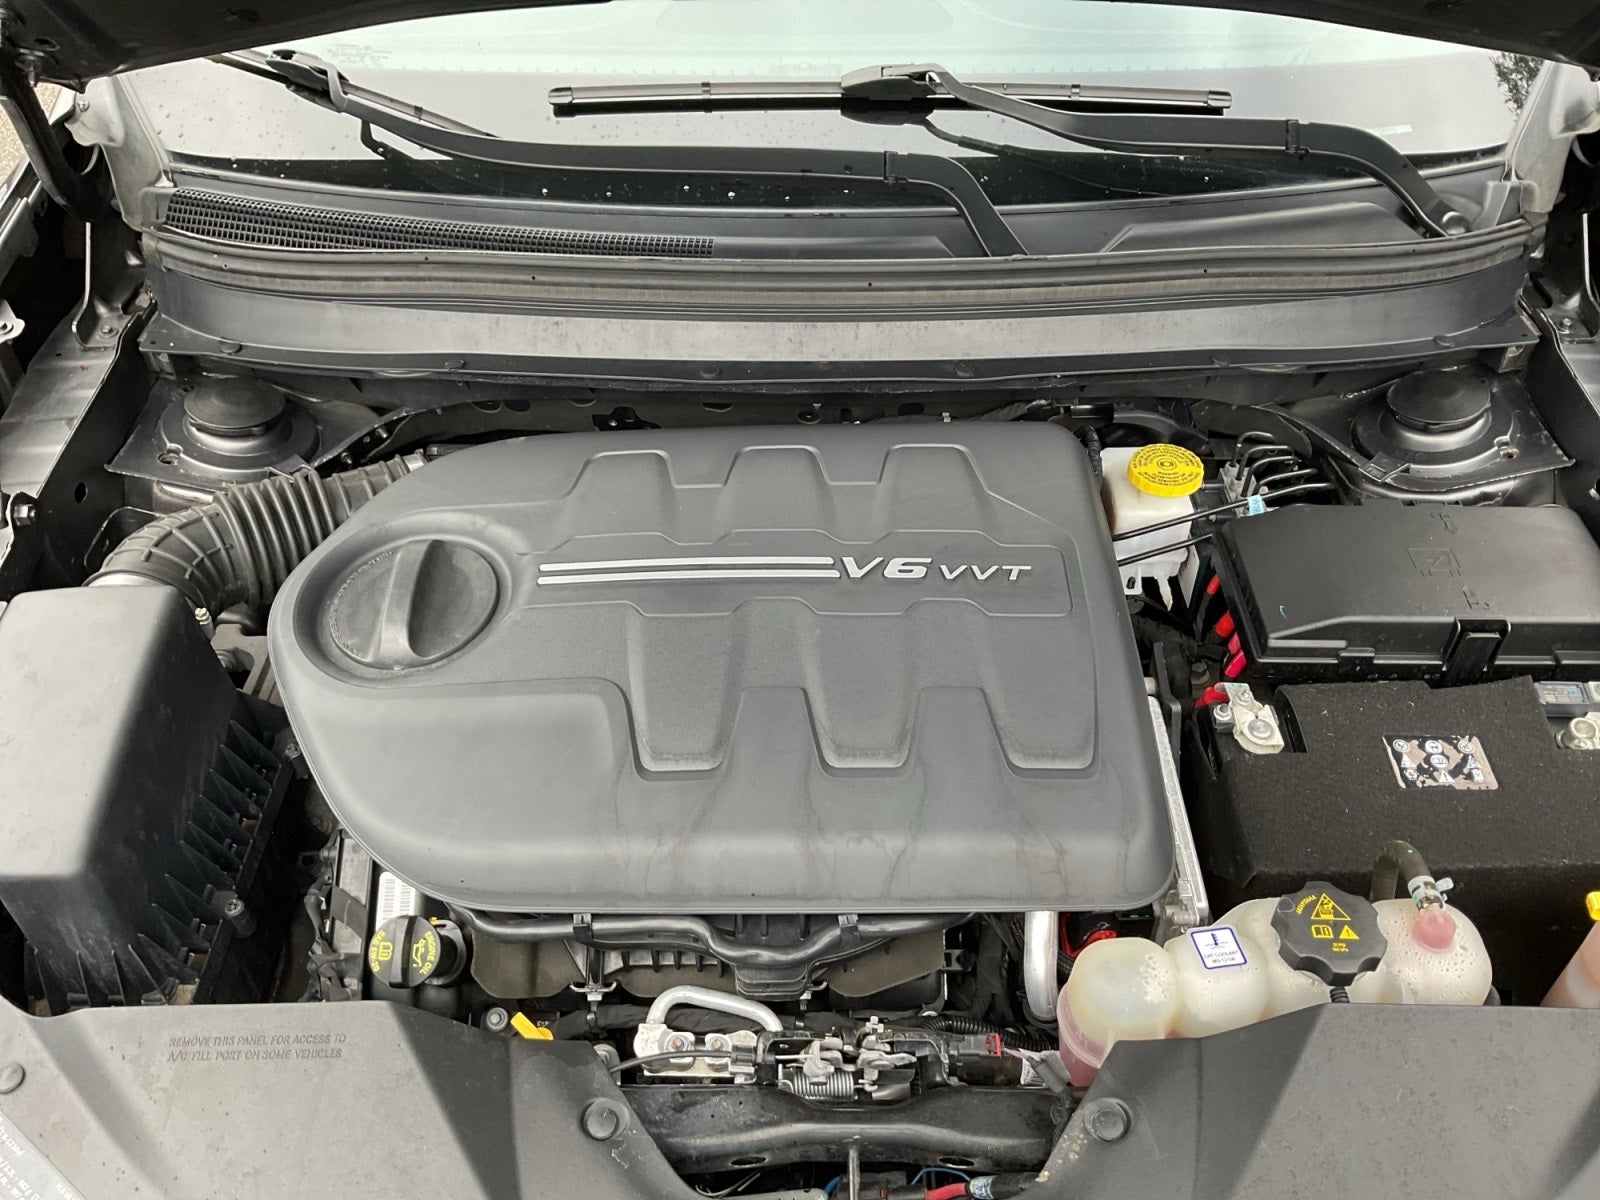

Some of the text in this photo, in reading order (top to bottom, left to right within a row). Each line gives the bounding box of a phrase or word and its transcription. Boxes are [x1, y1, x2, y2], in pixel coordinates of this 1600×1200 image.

[841, 556, 1032, 580] V6 VVT
[419, 930, 436, 974] ENGINE OIL
[169, 1032, 347, 1047] REMOVE THIS PANEL FOR ACCESS TO
[191, 1050, 212, 1061] FILL
[215, 1049, 242, 1061] PORT
[244, 1049, 260, 1060] ON
[261, 1048, 291, 1060] SOME
[294, 1047, 343, 1060] VEHICLES
